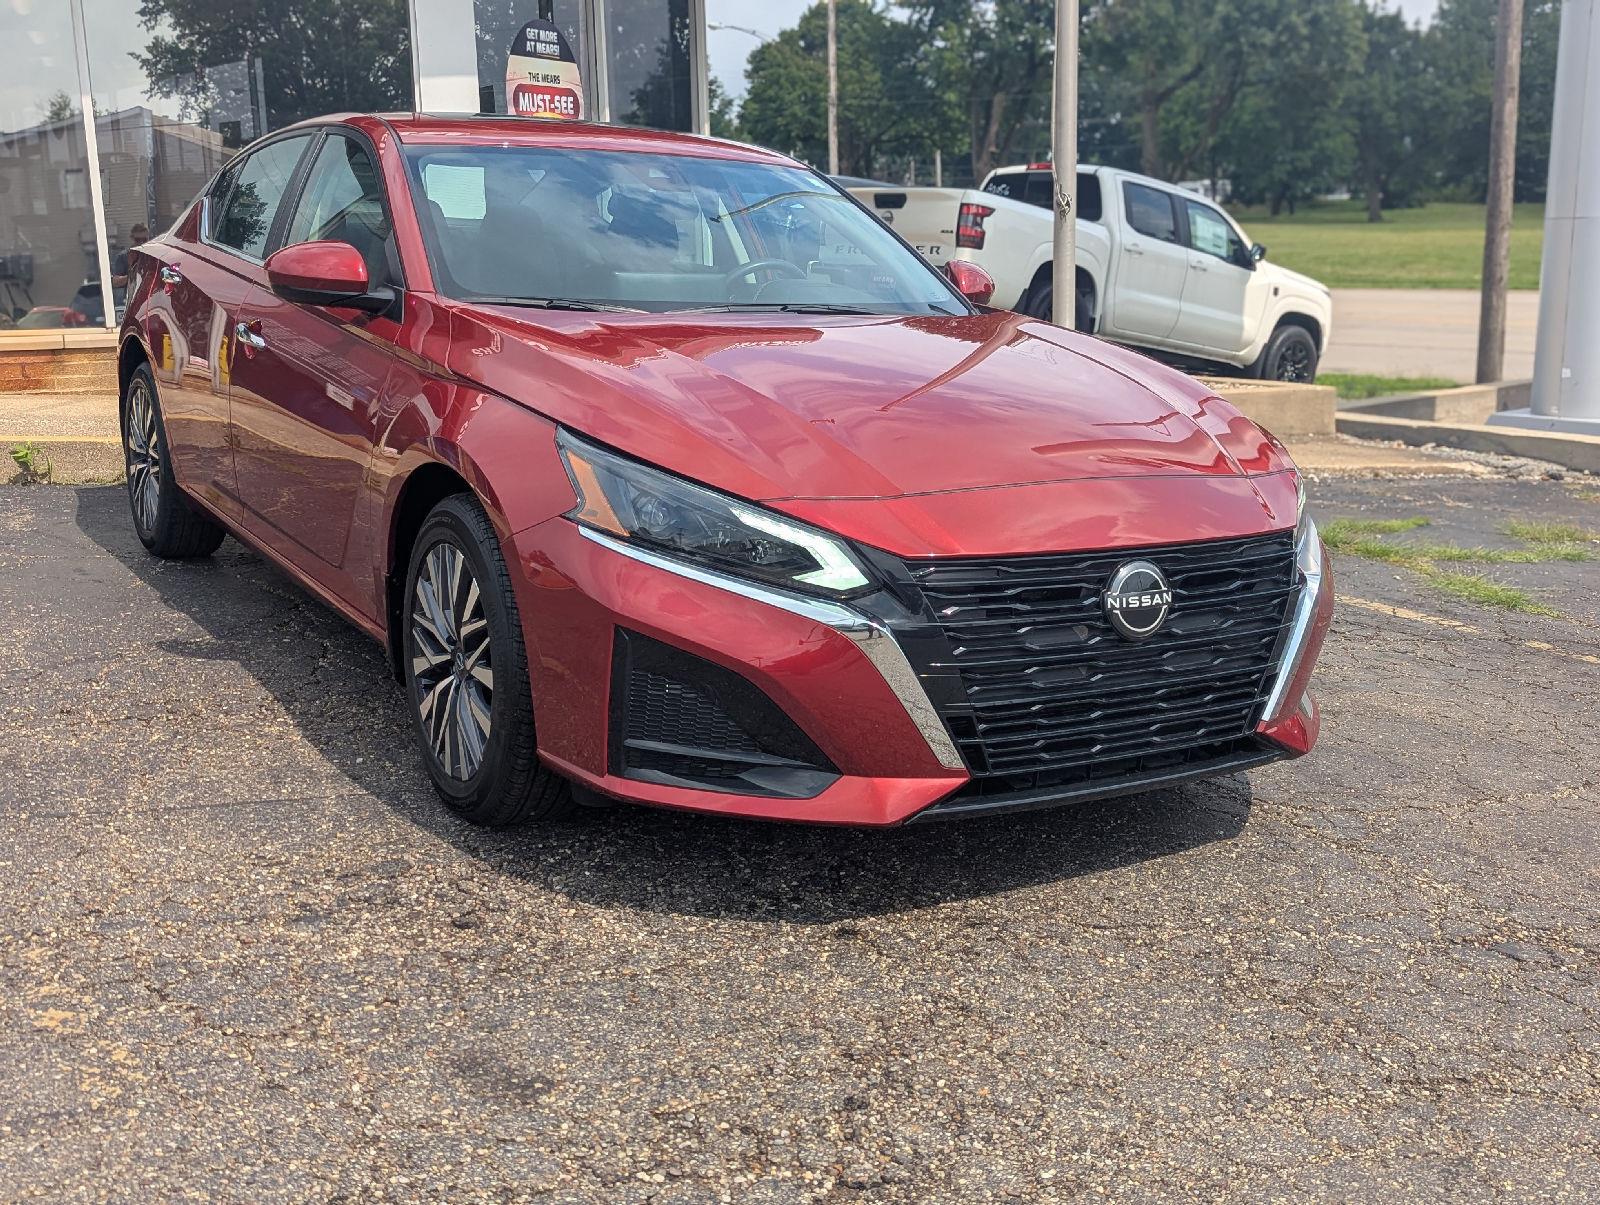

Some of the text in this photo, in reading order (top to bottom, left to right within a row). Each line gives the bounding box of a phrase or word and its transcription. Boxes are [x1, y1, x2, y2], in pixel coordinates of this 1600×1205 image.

[526, 28, 558, 42] GET MORE
[526, 41, 560, 55] AT MEARS!
[528, 72, 561, 84] THE MEARS
[519, 92, 574, 115] MUST-SEE
[1107, 591, 1172, 609] NISSAN
